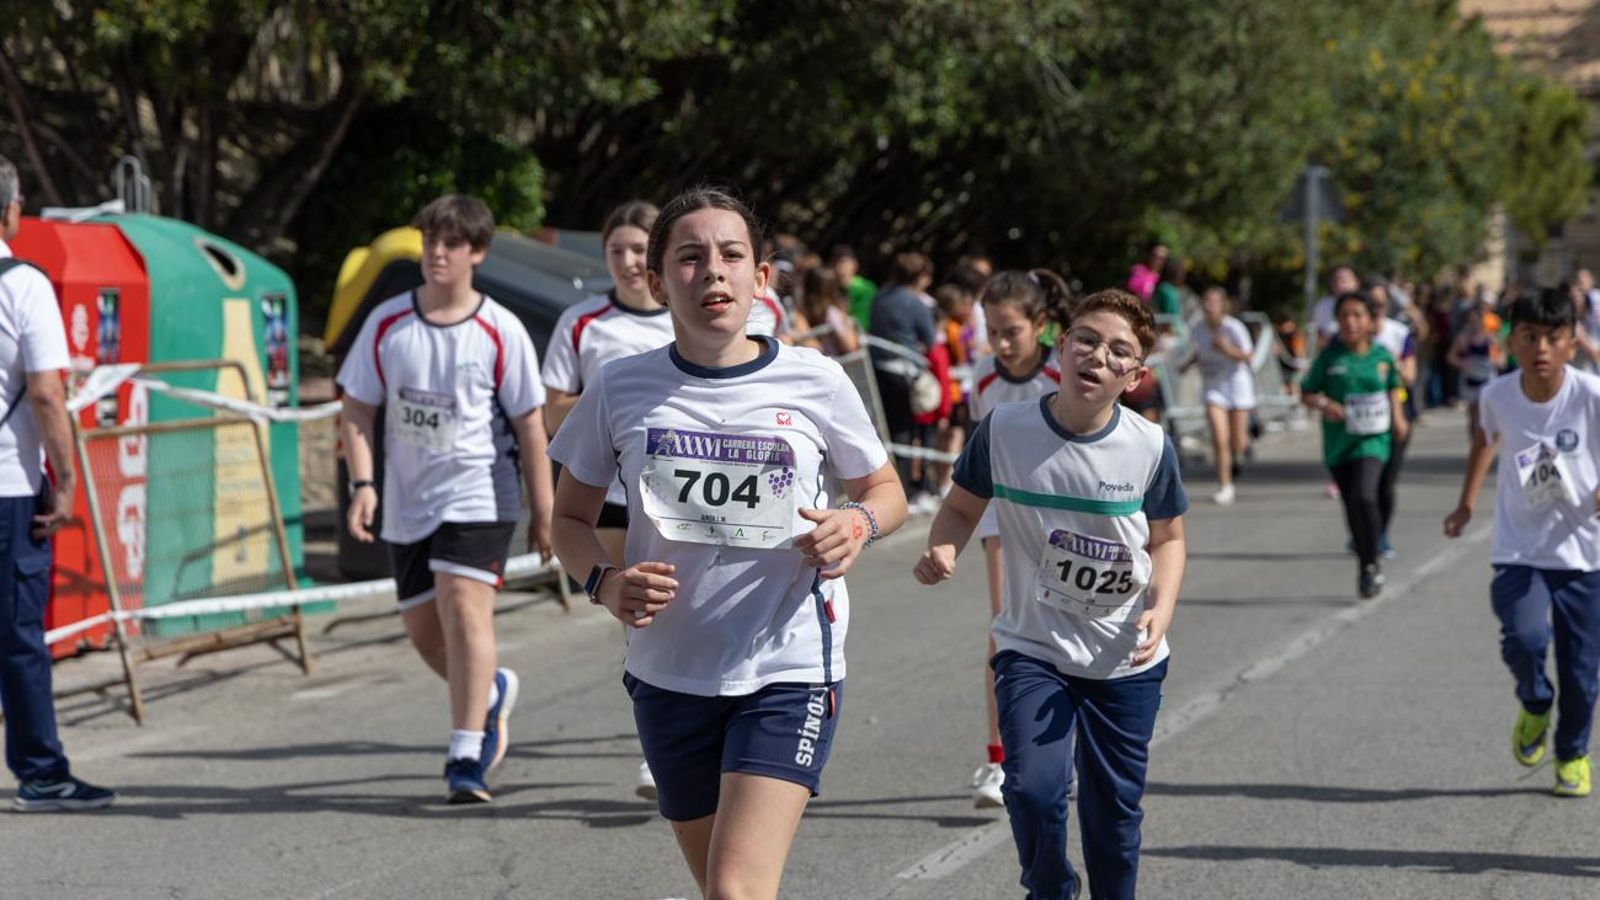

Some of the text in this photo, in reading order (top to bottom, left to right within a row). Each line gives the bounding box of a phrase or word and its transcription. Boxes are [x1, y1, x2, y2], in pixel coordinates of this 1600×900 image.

[402, 405, 440, 429] 304
[672, 434, 791, 458] XXXVI CARRERA ESCOLAR
[728, 448, 780, 462] LA GLORIA
[673, 468, 760, 510] 704
[1098, 481, 1134, 494] Poveda
[1056, 559, 1133, 595] 1025
[795, 687, 827, 768] SPÍNOL
